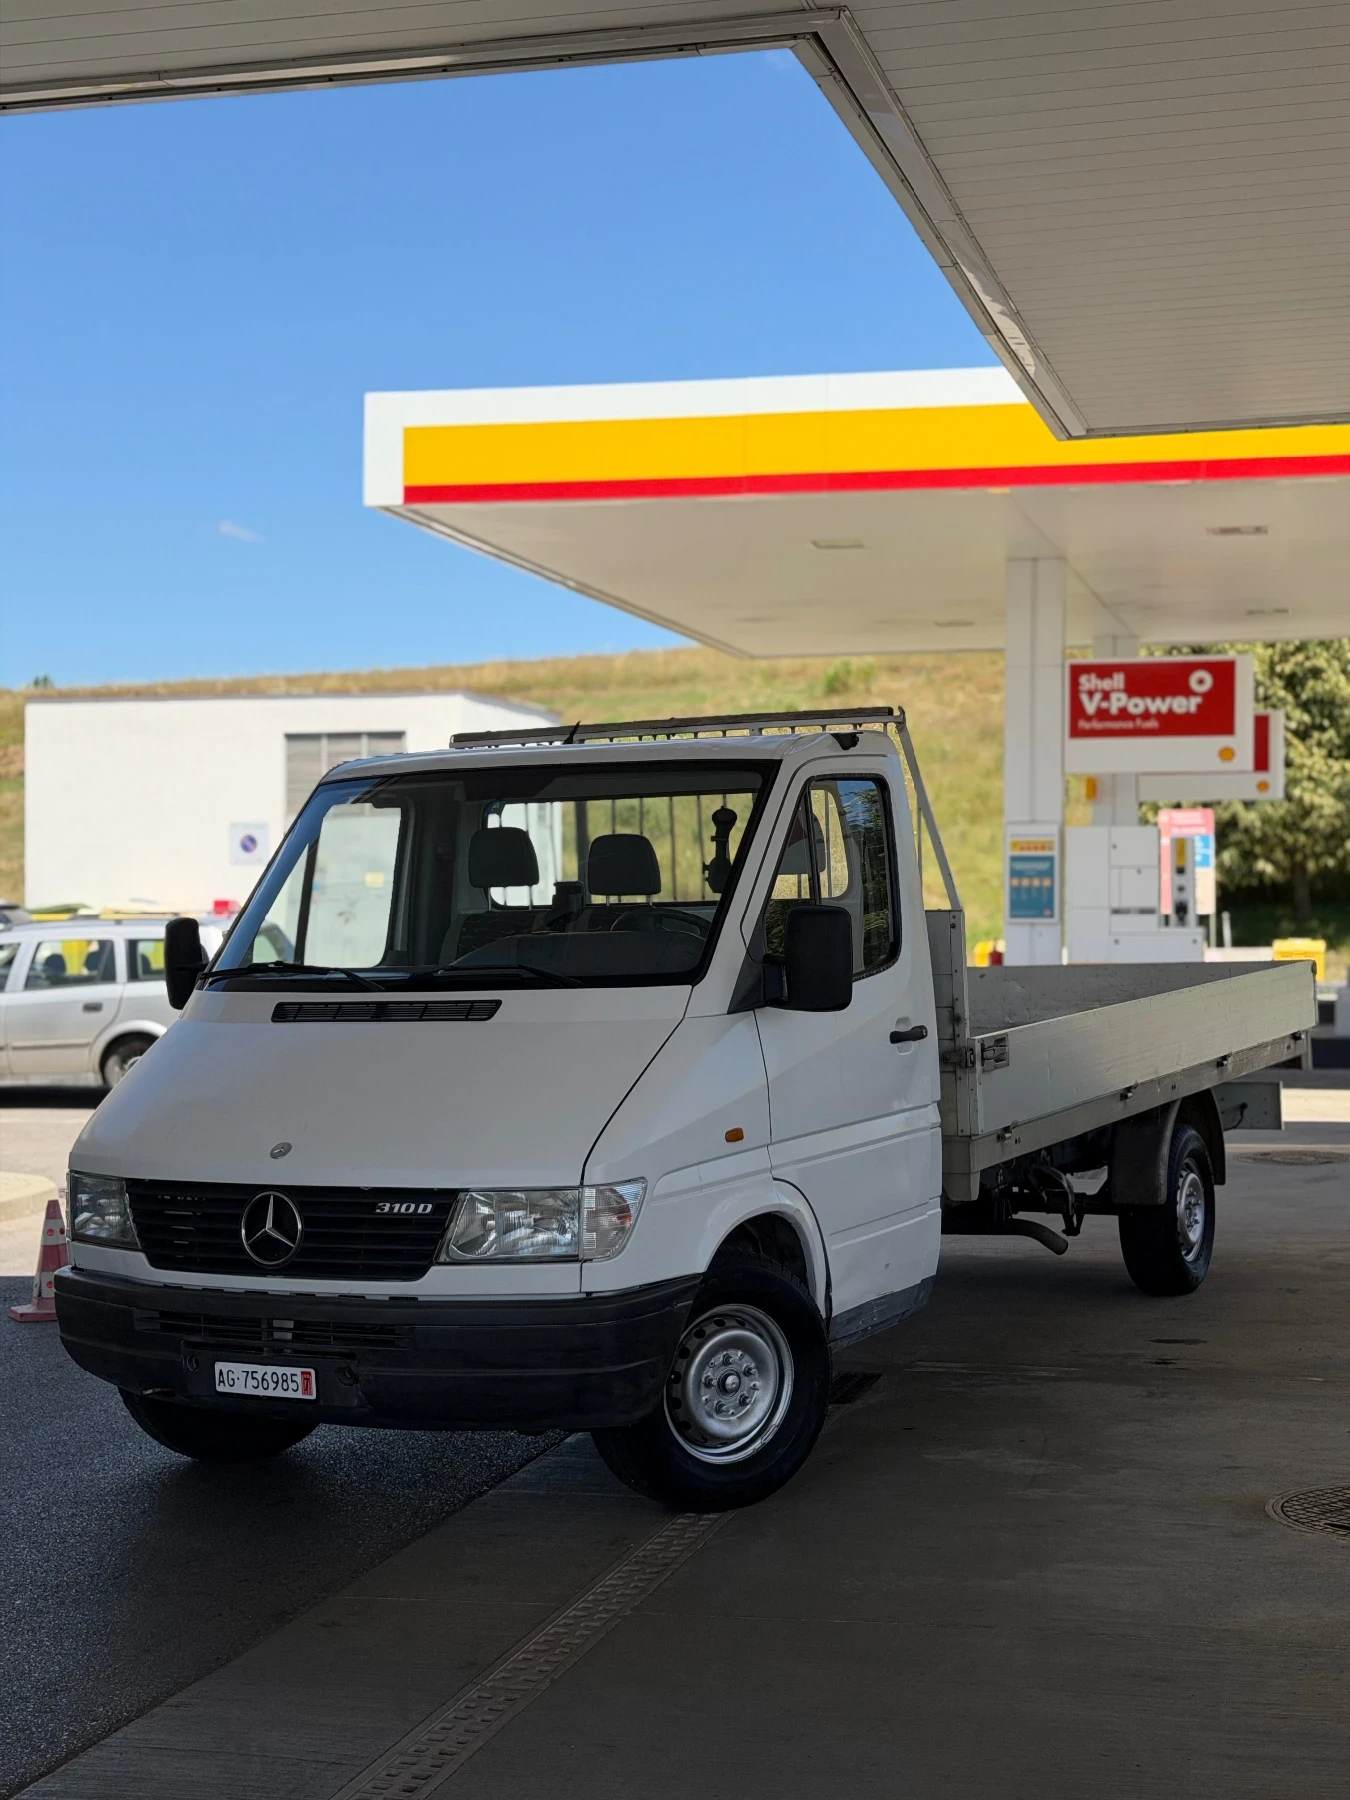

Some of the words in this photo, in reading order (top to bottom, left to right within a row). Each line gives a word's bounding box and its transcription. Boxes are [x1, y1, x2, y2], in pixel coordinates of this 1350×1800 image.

[1078, 672, 1124, 691] Shell
[1079, 691, 1202, 716] V-Power
[1078, 719, 1134, 730] Performance
[1136, 717, 1159, 729] Fuels
